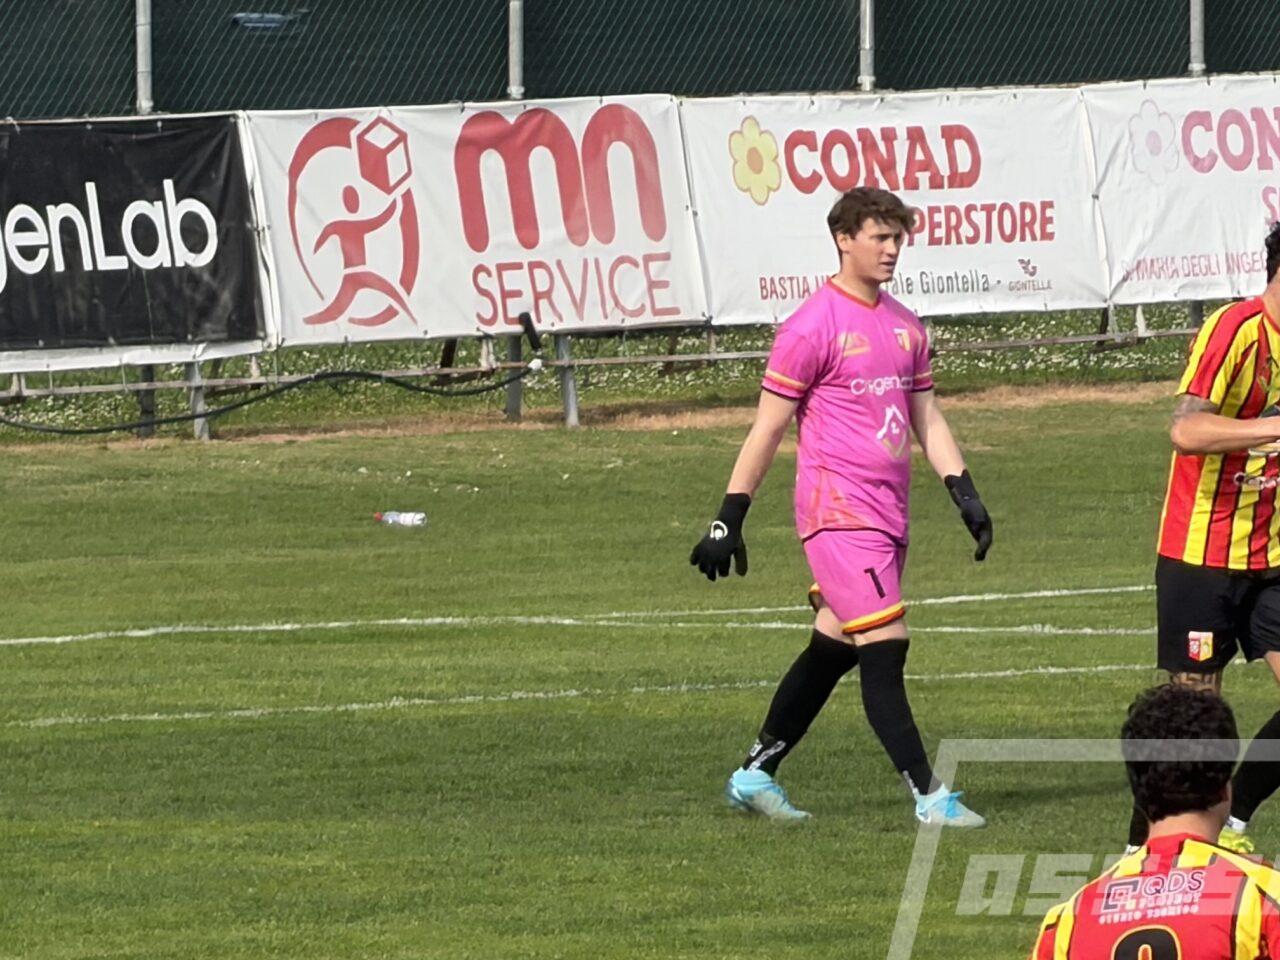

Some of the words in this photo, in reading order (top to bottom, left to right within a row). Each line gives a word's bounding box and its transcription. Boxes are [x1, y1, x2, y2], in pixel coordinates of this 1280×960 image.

[783, 124, 982, 194] CONAD
[0, 178, 218, 292] enLab
[901, 201, 1055, 247] PERSTORE
[471, 252, 681, 327] SERVICE
[759, 275, 812, 300] BASTIA
[919, 270, 990, 294] Giontella
[864, 568, 886, 599] 1
[1143, 870, 1205, 896] QDS
